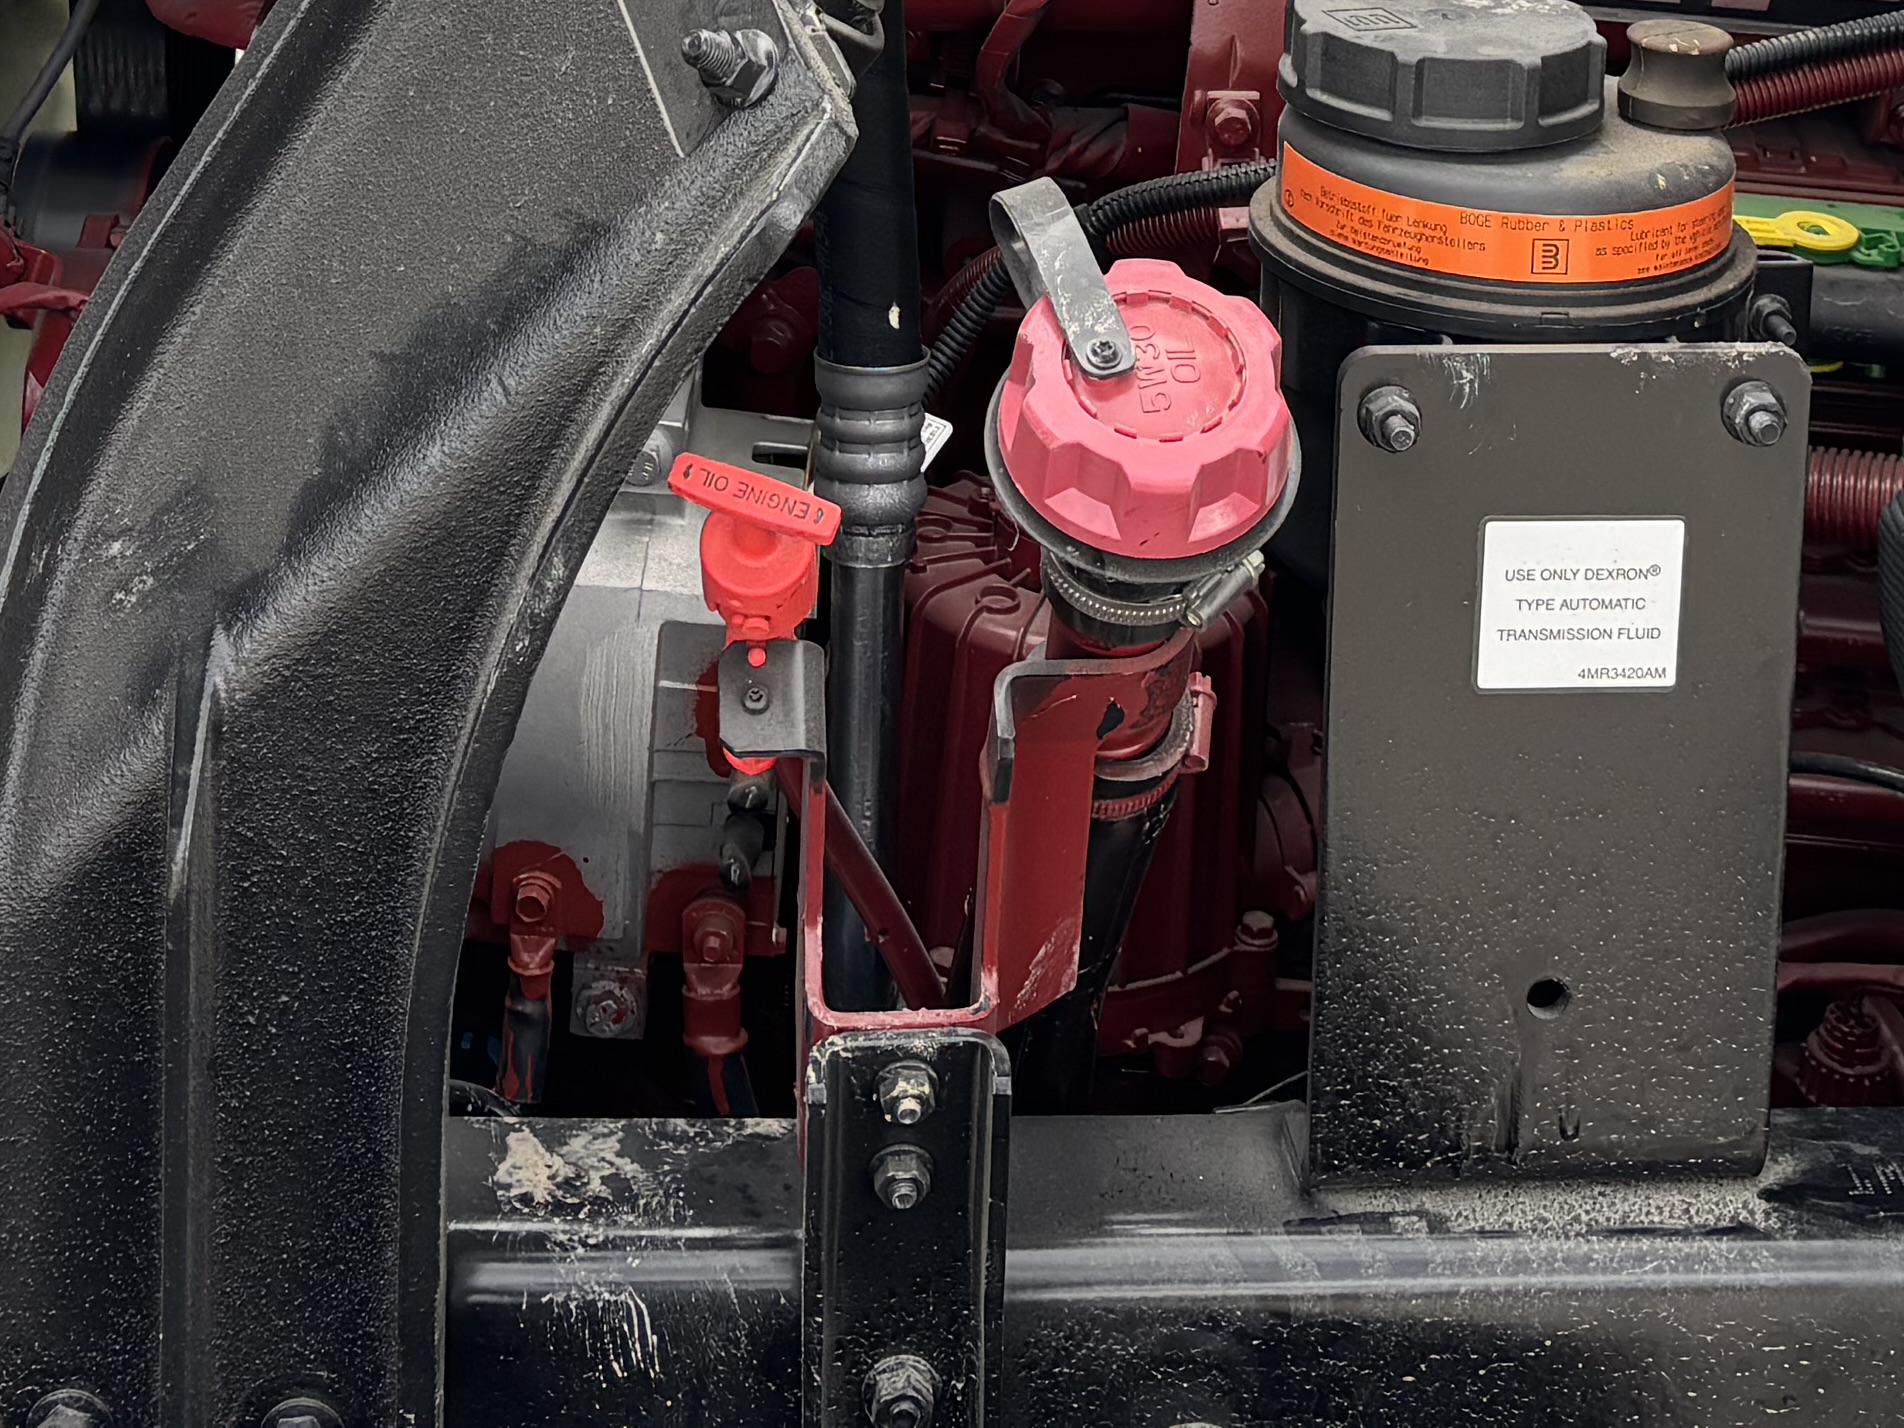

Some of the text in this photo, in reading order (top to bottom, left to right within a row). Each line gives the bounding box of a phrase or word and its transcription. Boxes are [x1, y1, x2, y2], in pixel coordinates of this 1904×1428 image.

[1460, 211, 1634, 232] BOGE Rubber & Plastics
[1165, 336, 1201, 384] OIL
[1131, 325, 1172, 414] 5W30
[700, 467, 811, 520] ENGINE OIL
[1505, 569, 1536, 582] USE
[1540, 568, 1580, 581] ONLY
[1516, 597, 1647, 611] TYPE AUTOMATIC
[1496, 627, 1661, 642] TRANSMISSION FLUID
[1577, 667, 1667, 680] 4MR3420AM
